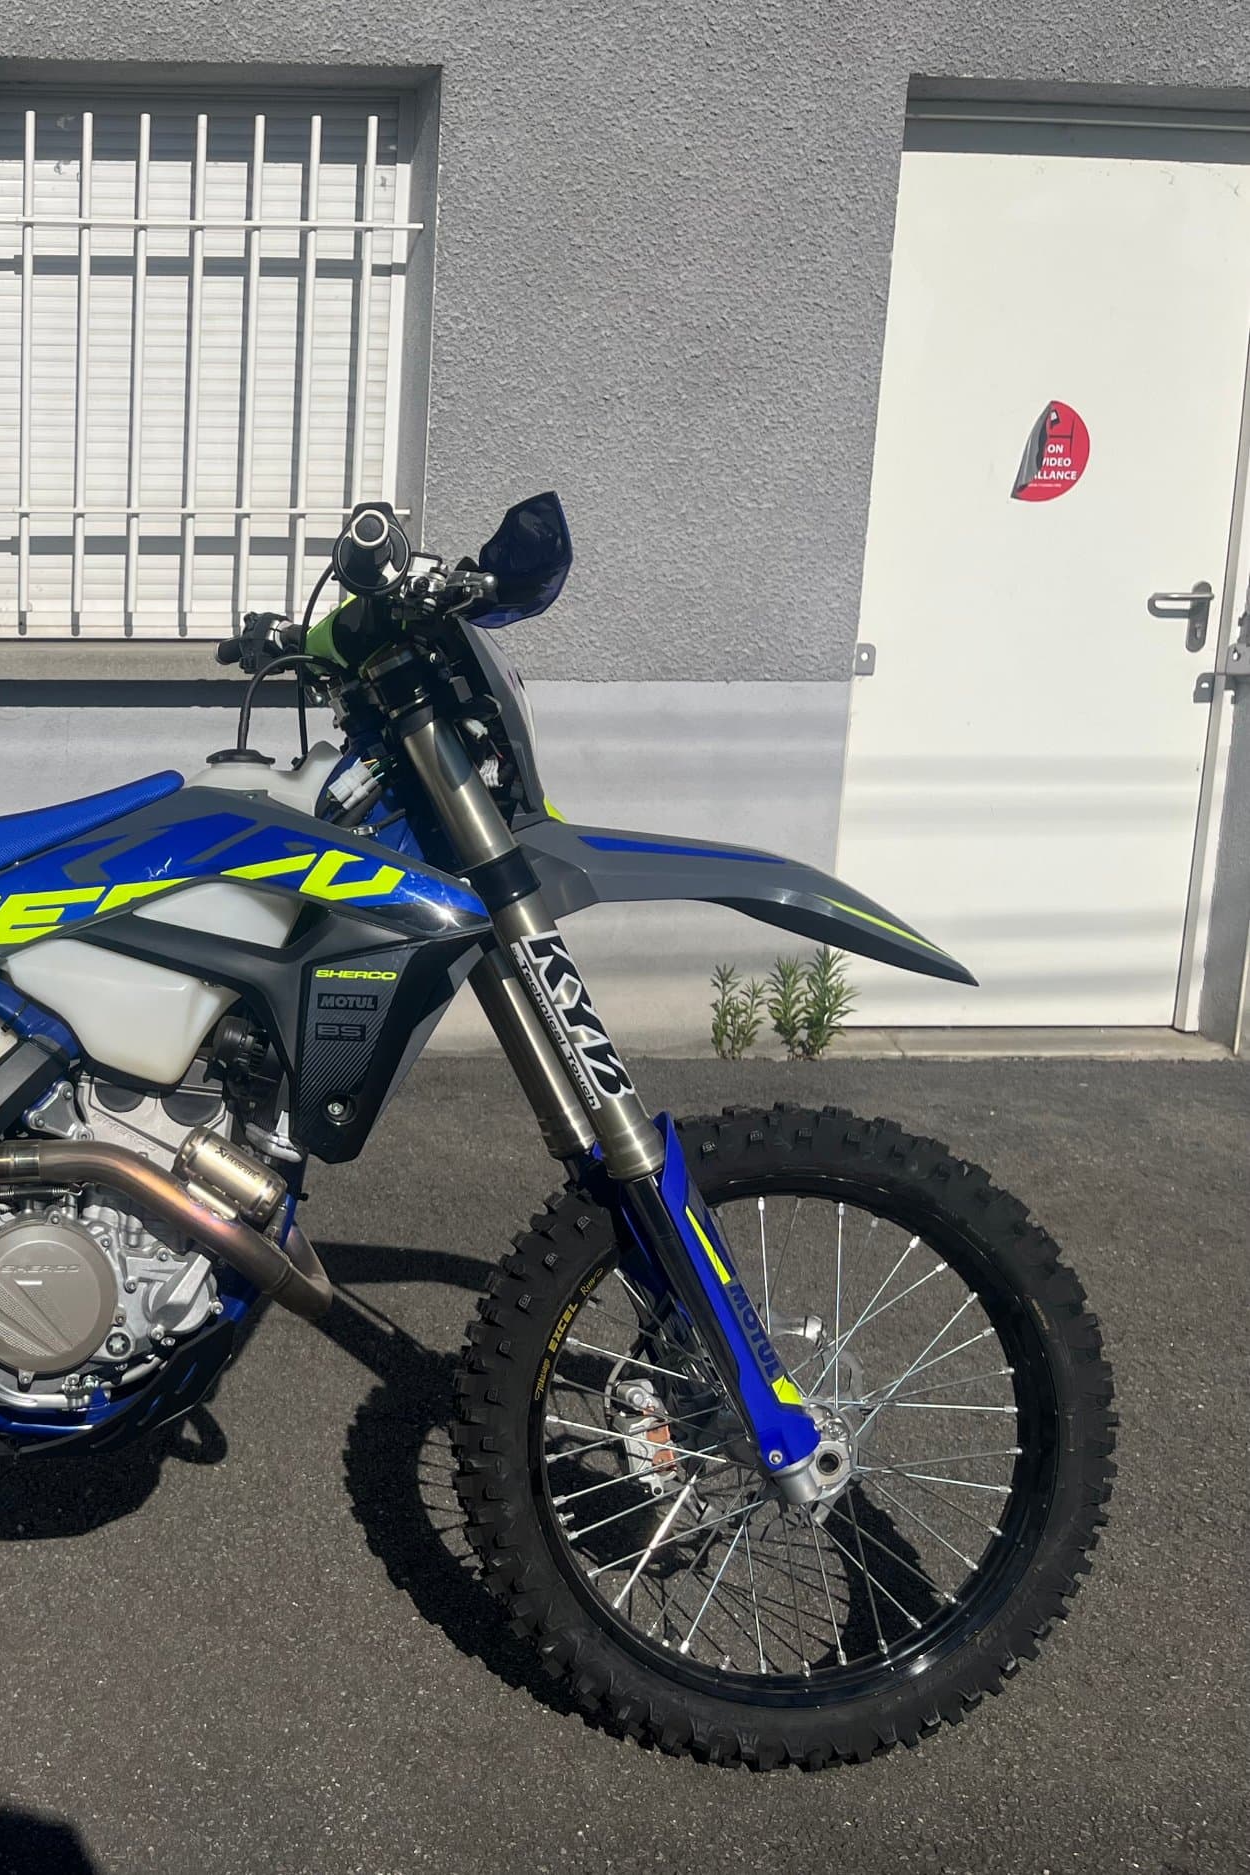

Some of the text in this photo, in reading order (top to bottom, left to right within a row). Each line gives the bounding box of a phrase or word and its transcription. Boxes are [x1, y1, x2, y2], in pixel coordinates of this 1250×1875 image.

[1047, 444, 1064, 454] ON
[315, 969, 398, 981] SHERCO
[320, 995, 375, 1009] MOTUL
[521, 931, 635, 1098] KYB
[317, 1025, 362, 1037] BS
[520, 959, 598, 1109] Technical Touch
[548, 1303, 578, 1352] EXCEL
[729, 1283, 782, 1378] MOTUL
